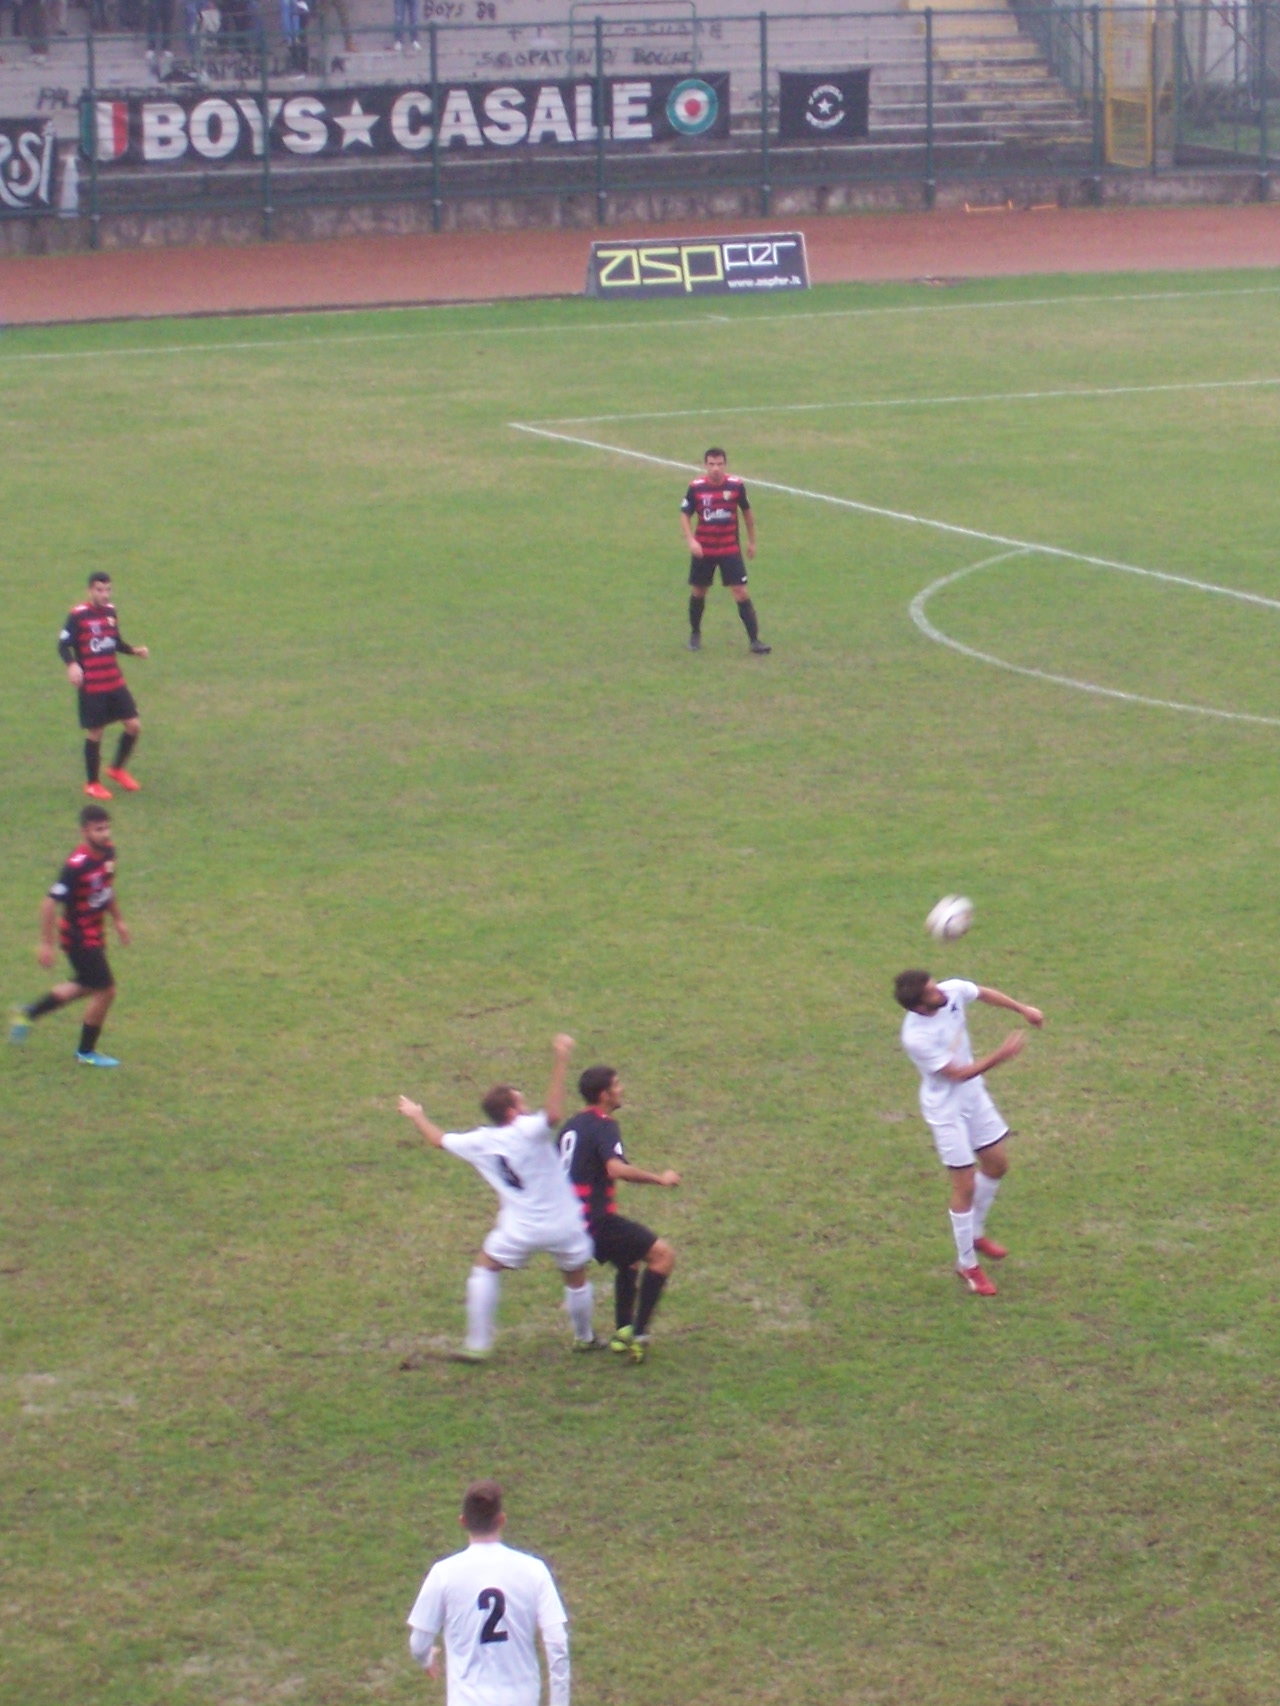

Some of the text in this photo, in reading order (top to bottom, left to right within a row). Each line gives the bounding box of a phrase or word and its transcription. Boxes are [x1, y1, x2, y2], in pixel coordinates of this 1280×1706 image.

[142, 81, 653, 160] BOYS CASALE
[477, 1586, 509, 1644] 2
